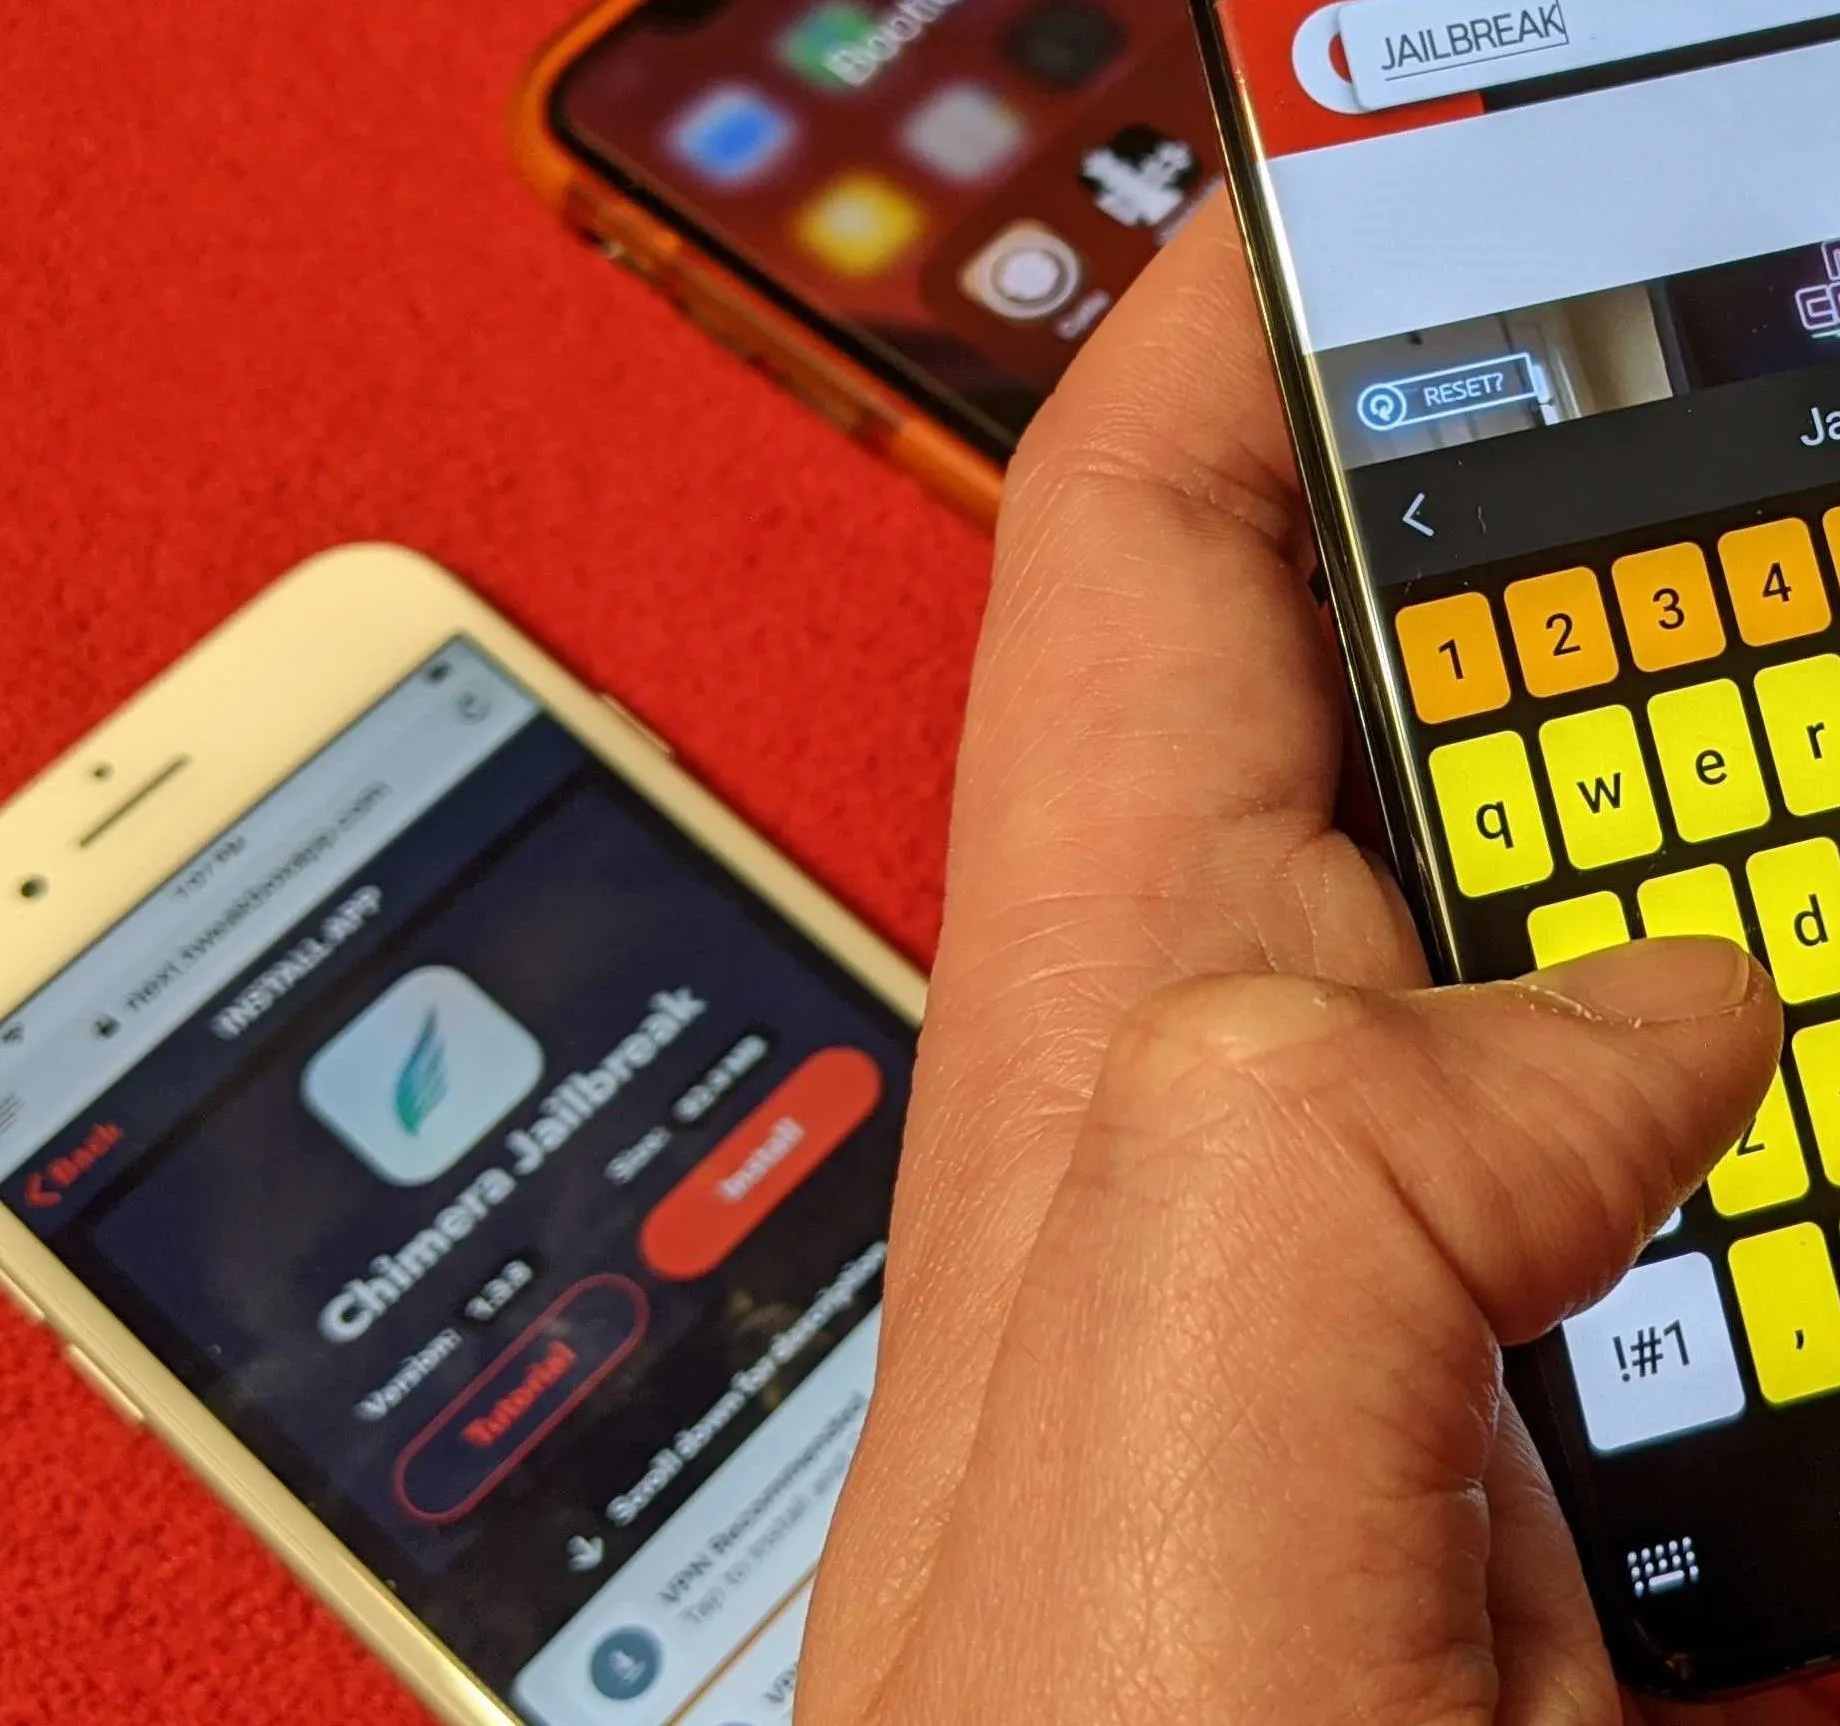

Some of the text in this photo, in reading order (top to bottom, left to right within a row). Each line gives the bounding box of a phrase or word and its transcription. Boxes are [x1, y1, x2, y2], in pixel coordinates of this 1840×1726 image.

[1381, 2, 1566, 71] JAILBREAK
[1422, 372, 1504, 408] RESET?
[1438, 639, 1464, 680] 1
[1545, 612, 1581, 657] 2
[1652, 587, 1685, 630] 3
[1762, 562, 1792, 602] 4
[1475, 801, 1514, 849] q
[1576, 772, 1621, 814] w
[1695, 749, 1728, 786] e
[1806, 722, 1825, 760] r
[211, 884, 382, 1040] INSTALL APP
[1793, 893, 1829, 947] d
[318, 986, 706, 1342] Chimera Jailbreak
[717, 1117, 804, 1202] Install
[354, 1328, 463, 1420] Version:
[1613, 1320, 1690, 1382] !#1
[1795, 1329, 1805, 1350] ,
[462, 1340, 577, 1448] Tutorial
[606, 1447, 682, 1527] Scroll
[677, 1391, 747, 1461] down
[734, 1355, 777, 1399] for
